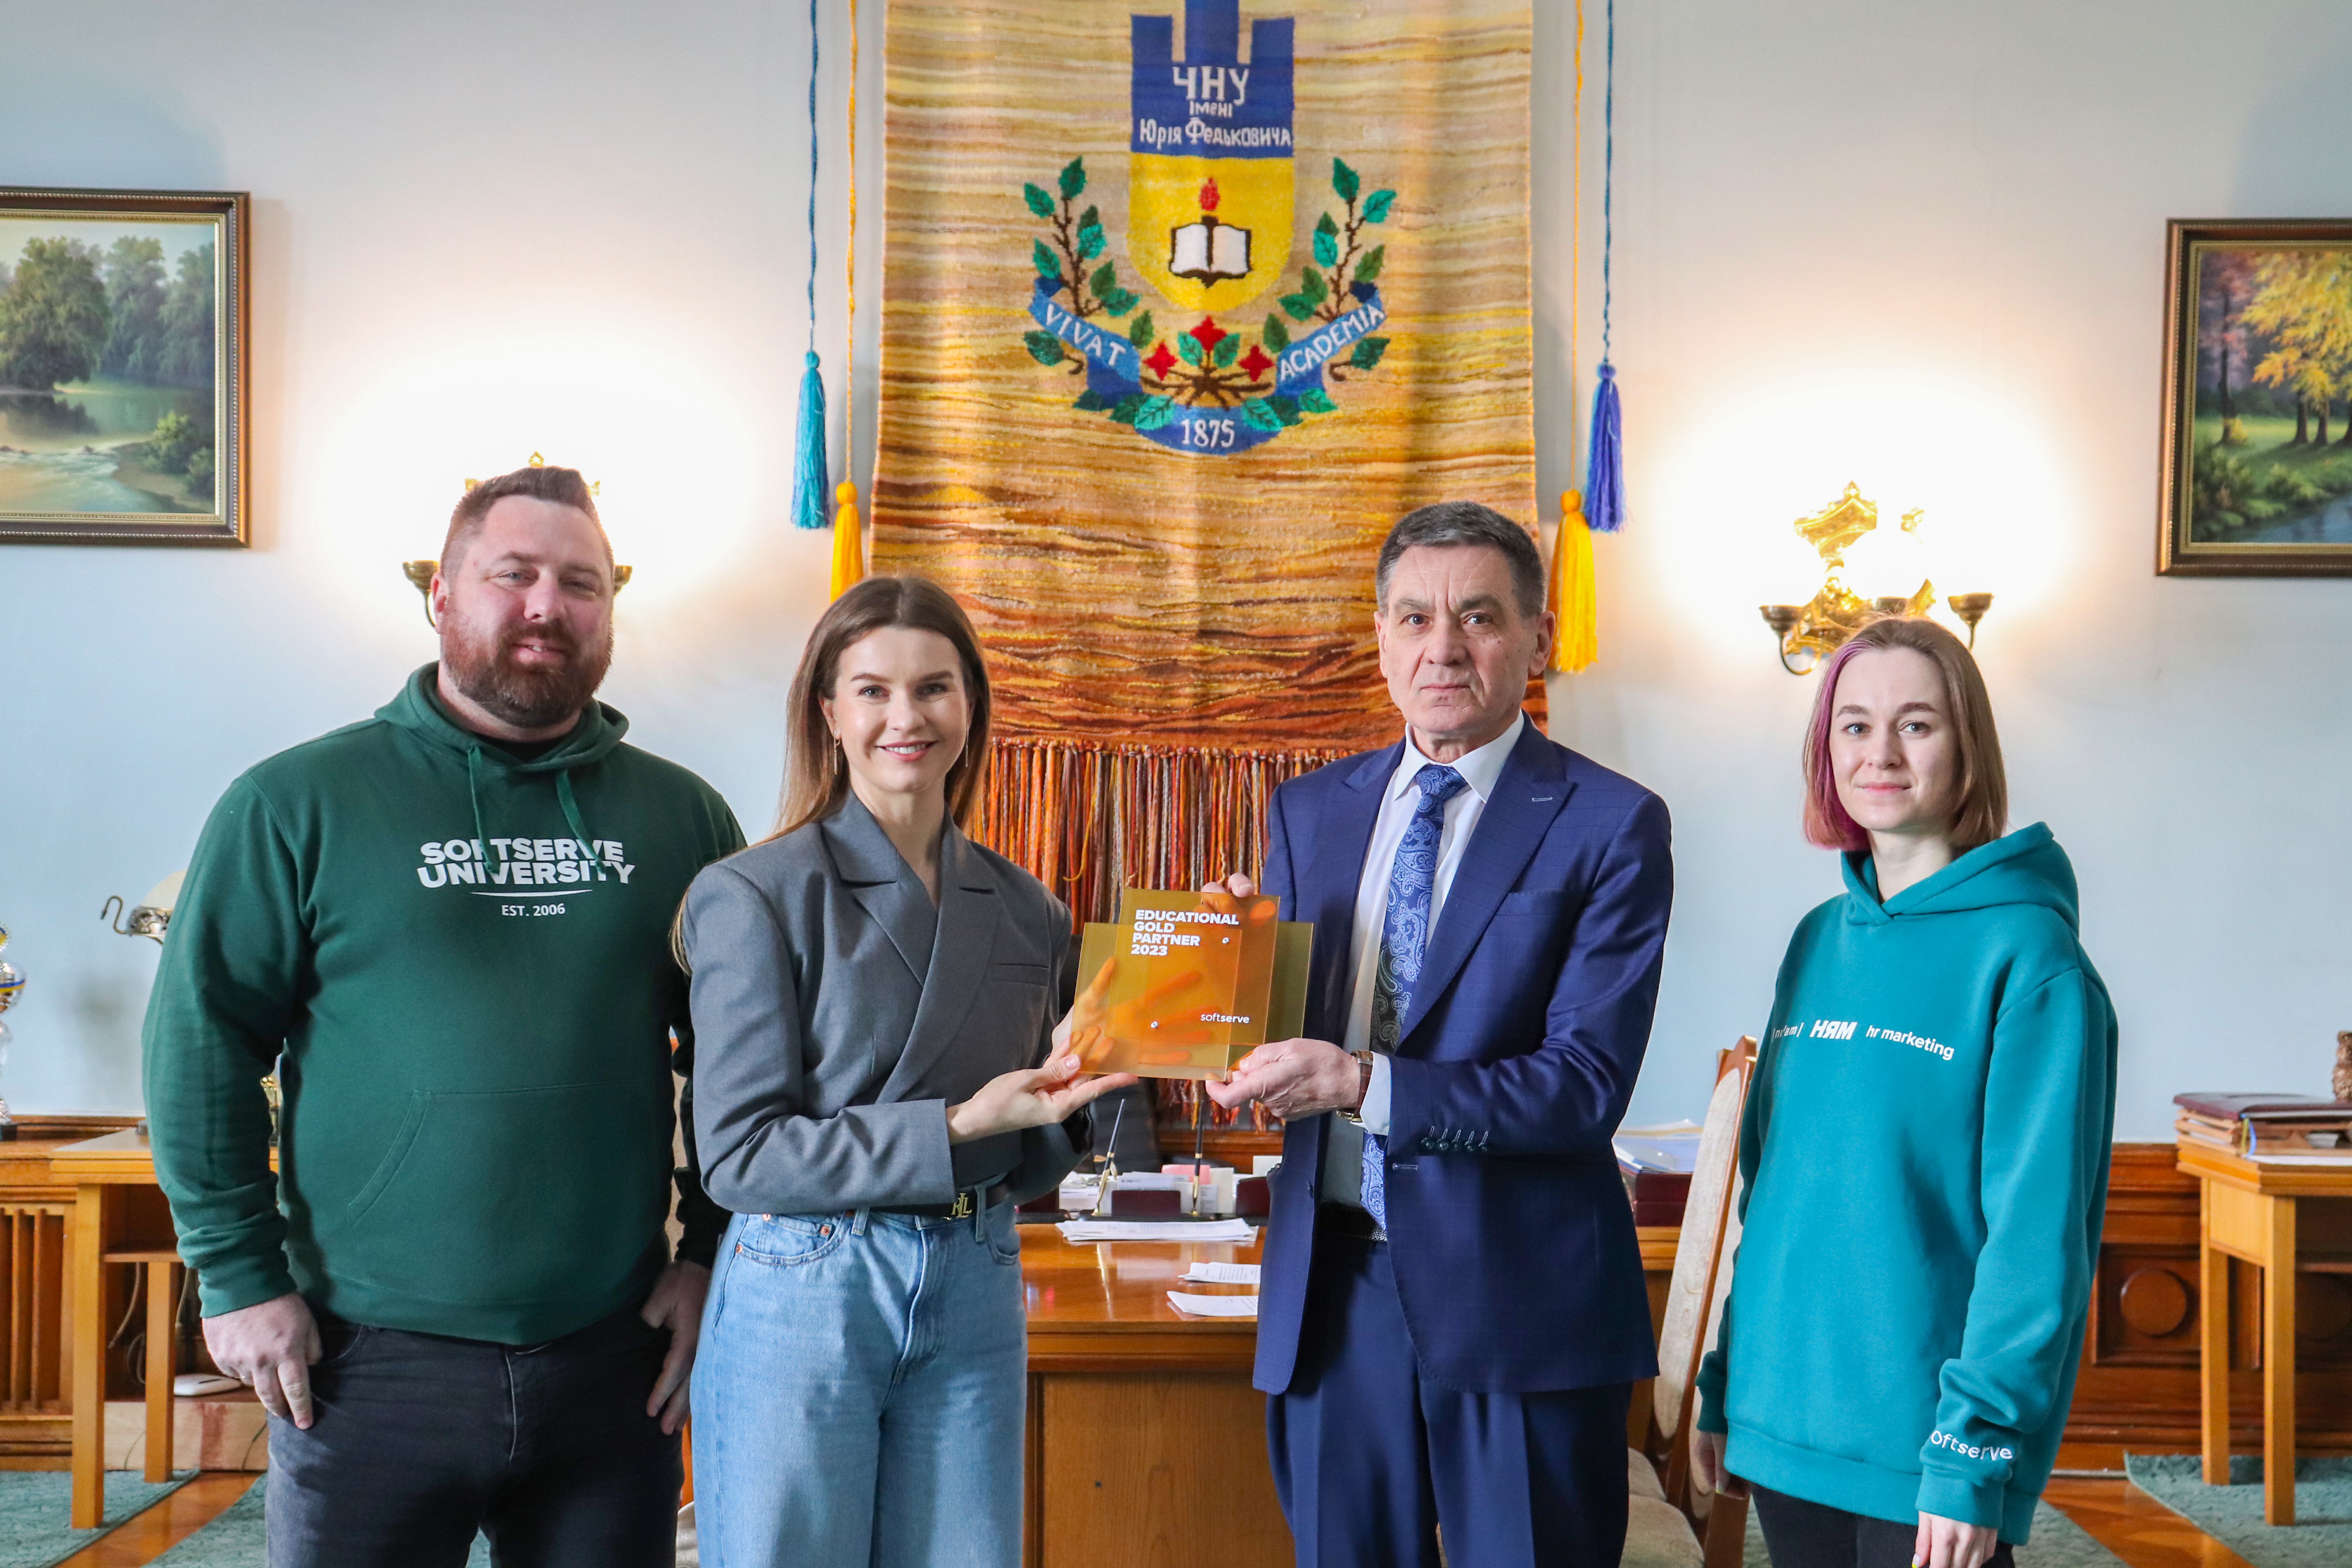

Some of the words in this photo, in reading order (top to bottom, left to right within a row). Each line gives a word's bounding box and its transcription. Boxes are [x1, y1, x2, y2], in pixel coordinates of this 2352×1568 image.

[1172, 66, 1249, 106] ЧНУ
[1139, 118, 1182, 151] Юрія
[1185, 116, 1292, 147] Федьковича
[1045, 303, 1126, 366] VIVAT
[1279, 303, 1385, 383] ACADEMIA
[1181, 419, 1236, 447] 1875
[417, 860, 635, 888] UNIVERSITY
[501, 904, 530, 917] EST.
[533, 903, 566, 917] 2006
[1135, 909, 1240, 925] EDUCATIONAL
[1132, 932, 1200, 946] PARTNER
[1133, 921, 1175, 933] GOLD
[1131, 945, 1168, 956] 2023
[1200, 1012, 1250, 1024] softserve
[1866, 1025, 1880, 1038] hr
[1880, 1028, 1955, 1061] marketing
[1929, 1429, 2013, 1461] oftserve
